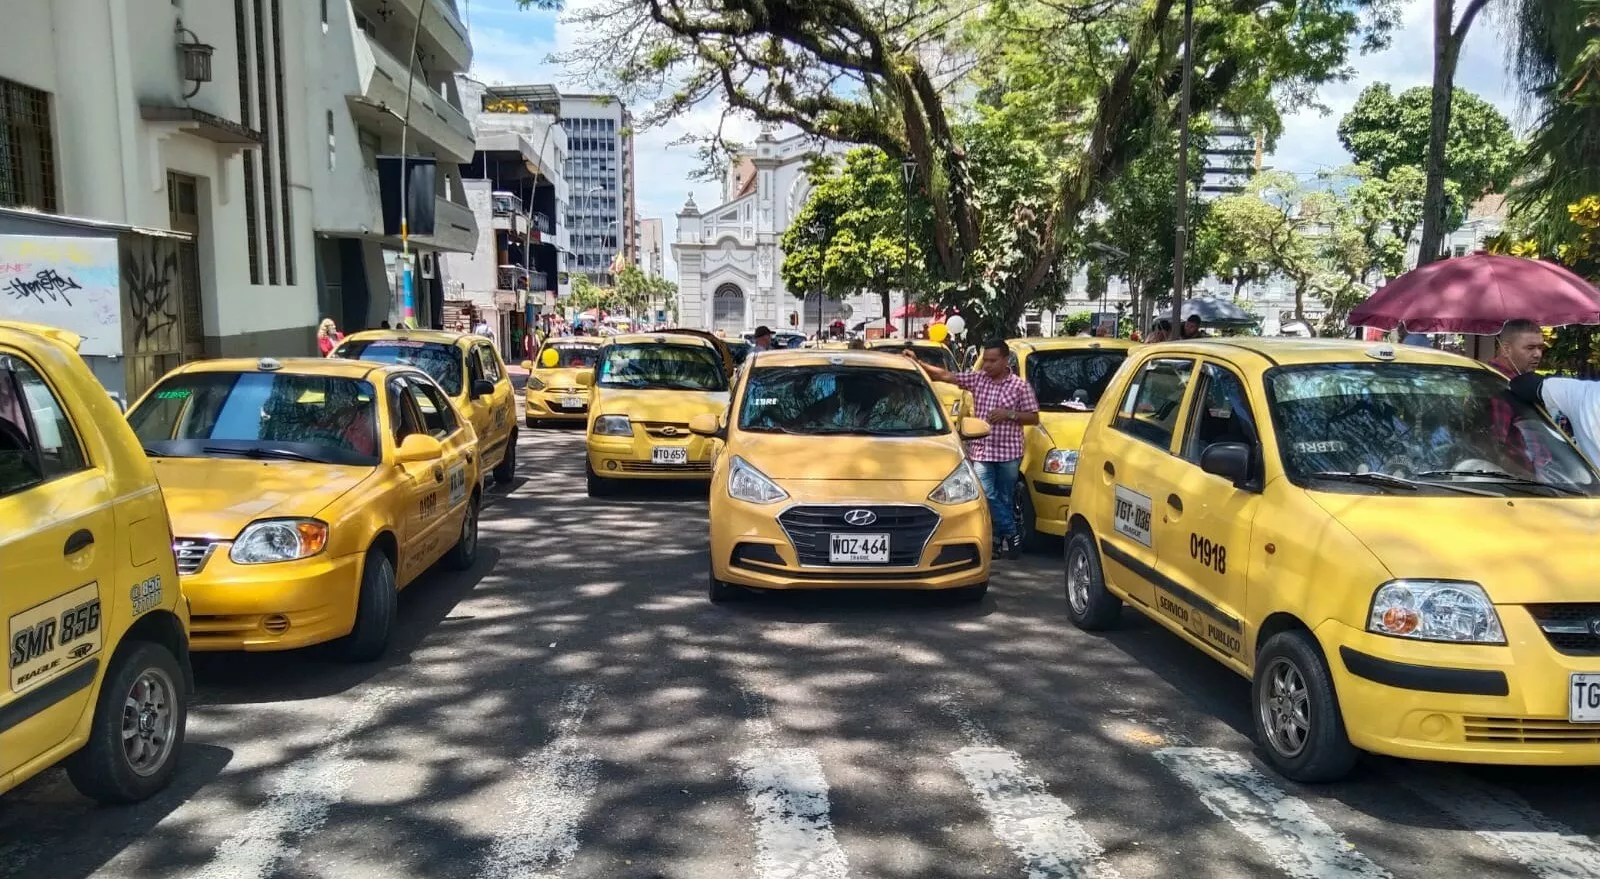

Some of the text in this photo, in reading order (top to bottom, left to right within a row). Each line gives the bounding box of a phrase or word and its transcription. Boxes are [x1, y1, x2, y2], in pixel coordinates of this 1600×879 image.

[1190, 532, 1226, 575] 01918
[142, 575, 161, 597] 856
[1160, 596, 1189, 622] SERVICIO
[10, 599, 101, 669] SMR 856
